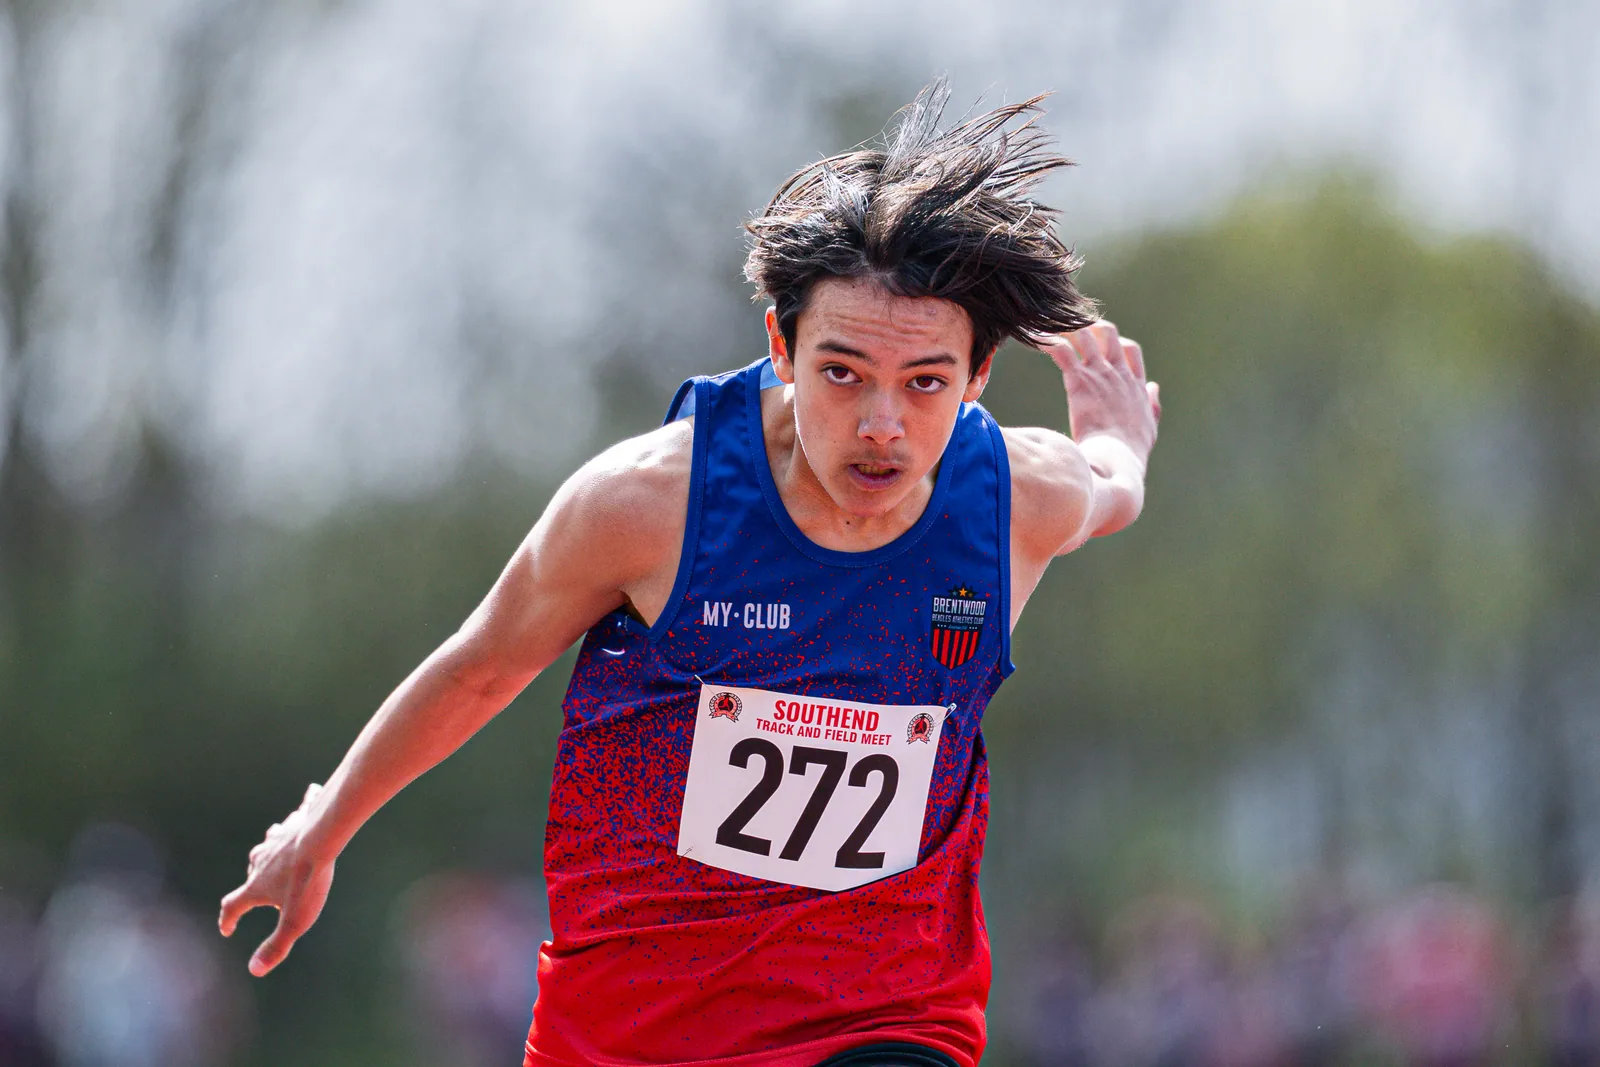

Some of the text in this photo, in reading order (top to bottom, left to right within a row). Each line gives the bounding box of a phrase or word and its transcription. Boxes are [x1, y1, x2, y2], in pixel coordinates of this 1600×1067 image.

[933, 597, 986, 616] BRENTWOOD
[952, 615, 974, 625] ATHLETICS
[974, 617, 984, 625] CLUB
[773, 700, 880, 732] SOUTHEND
[756, 718, 892, 746] TRACK AND FIELD MEET
[715, 737, 899, 869] 272
